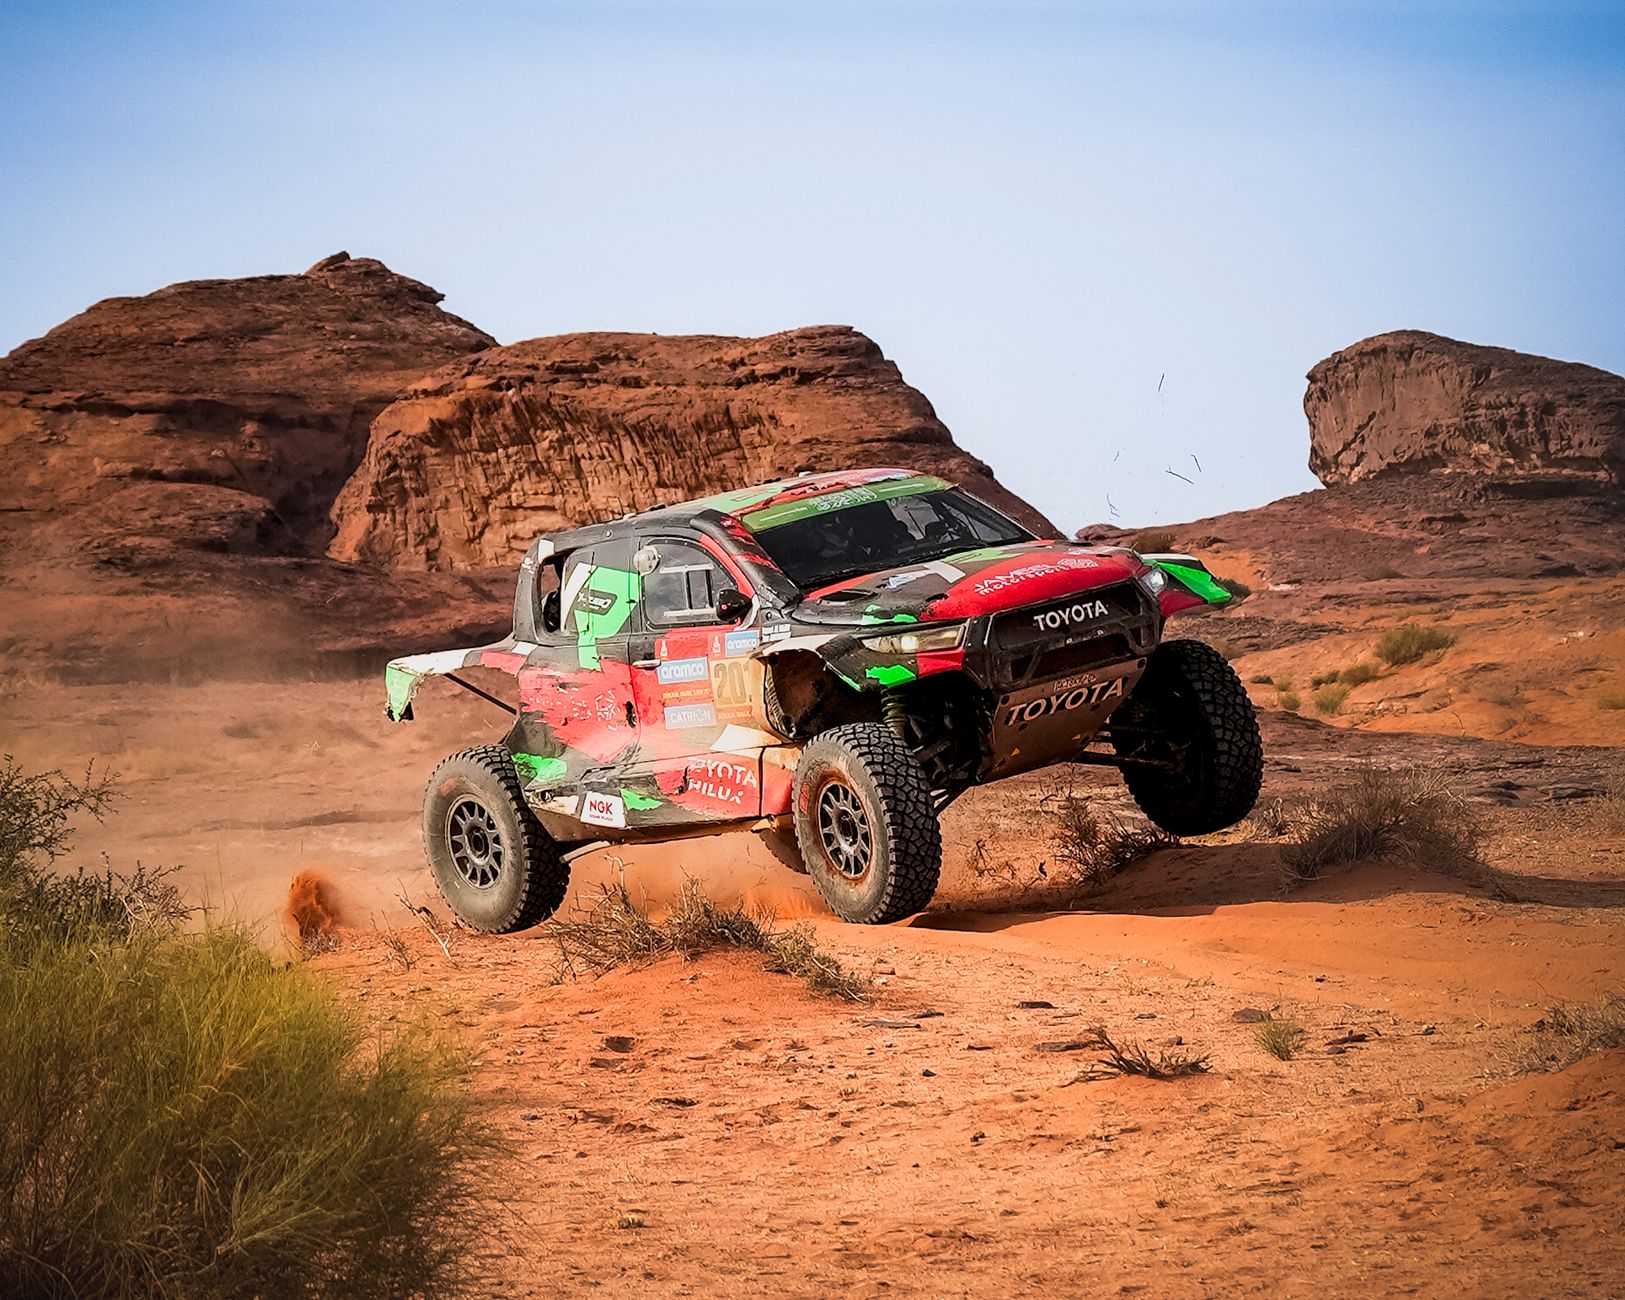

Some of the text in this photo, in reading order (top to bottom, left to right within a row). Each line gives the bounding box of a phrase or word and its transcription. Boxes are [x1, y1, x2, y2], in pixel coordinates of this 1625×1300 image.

[1033, 600, 1109, 631] TOYOTA
[727, 638, 758, 650] aramco
[661, 661, 704, 679] aramco
[1007, 677, 1123, 726] TOYOTA
[686, 756, 758, 789] YOTA
[688, 778, 744, 805] HILUX
[589, 799, 613, 816] NGK
